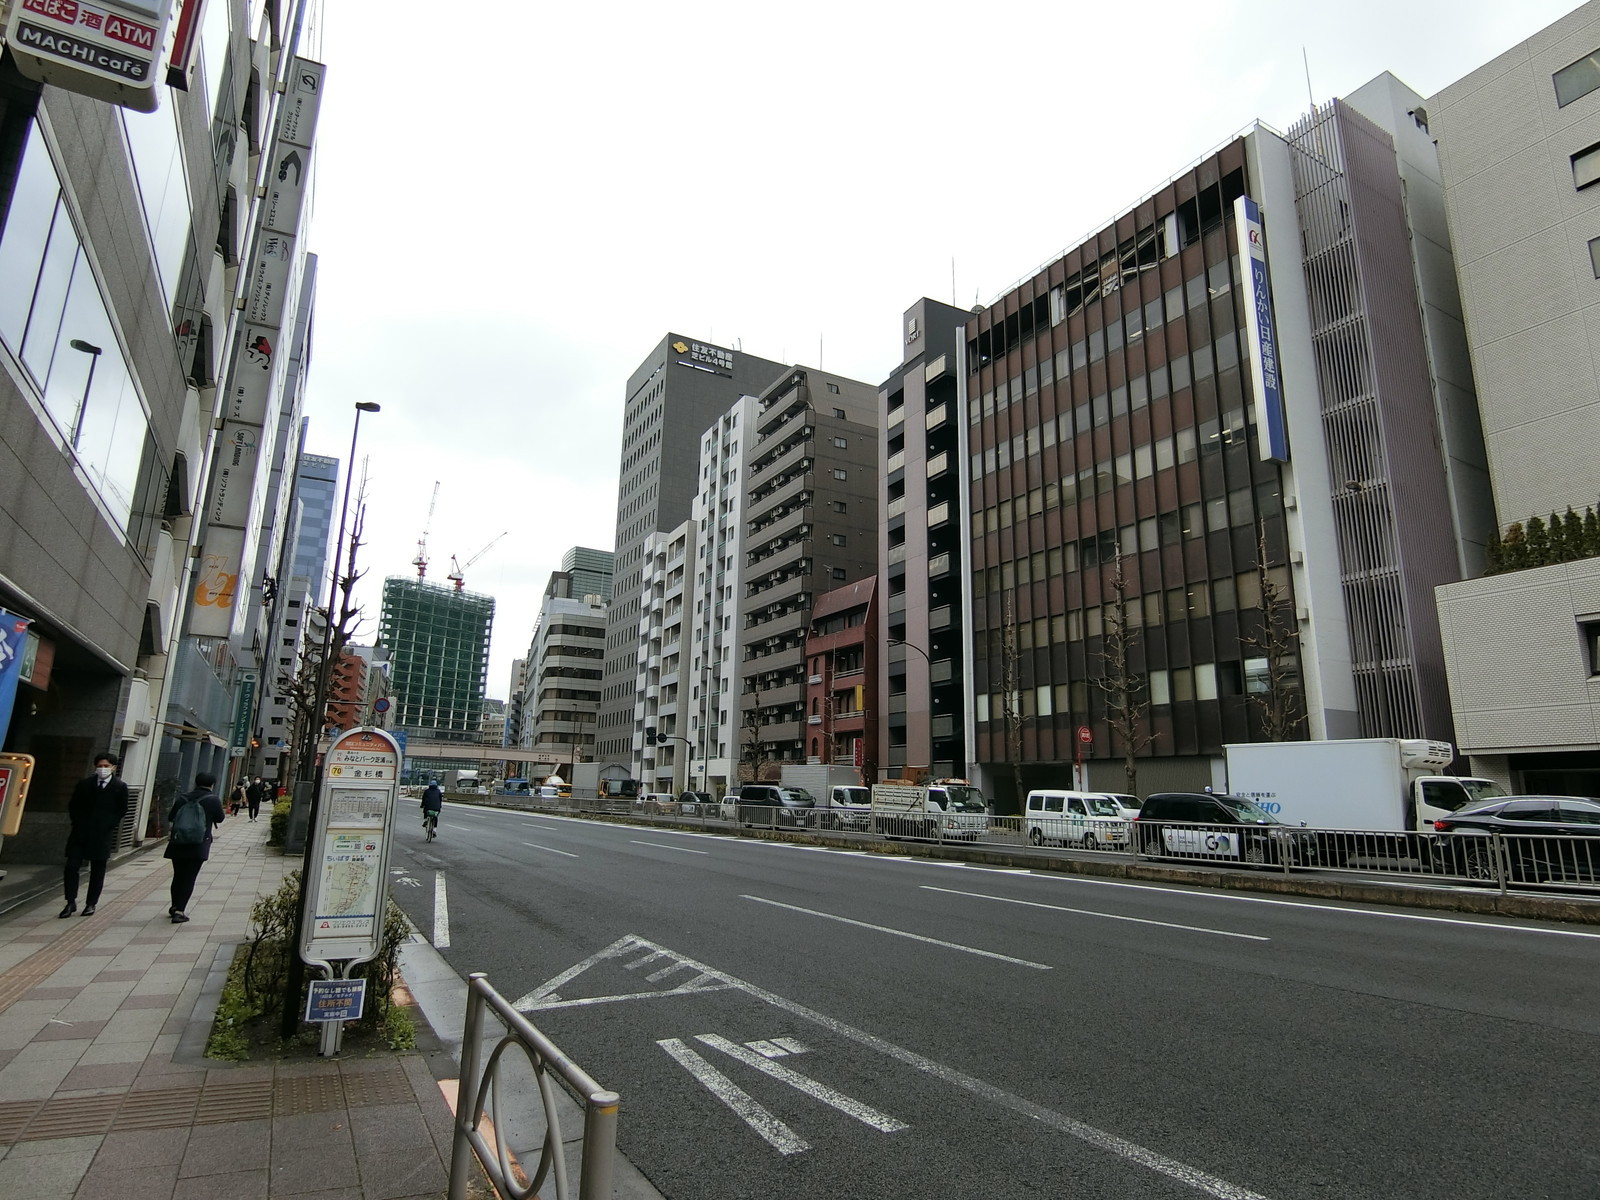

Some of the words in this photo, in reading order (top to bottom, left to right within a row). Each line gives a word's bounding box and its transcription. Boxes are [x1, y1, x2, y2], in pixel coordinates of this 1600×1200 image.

[27, 0, 76, 21] たばこ
[78, 9, 105, 29] 酒
[107, 20, 152, 47] ATM
[21, 27, 96, 63] MACHI
[97, 54, 143, 77] café
[1253, 267, 1277, 391] りんかい日産建設
[691, 343, 733, 362] 住友不動産
[333, 767, 342, 775] 70
